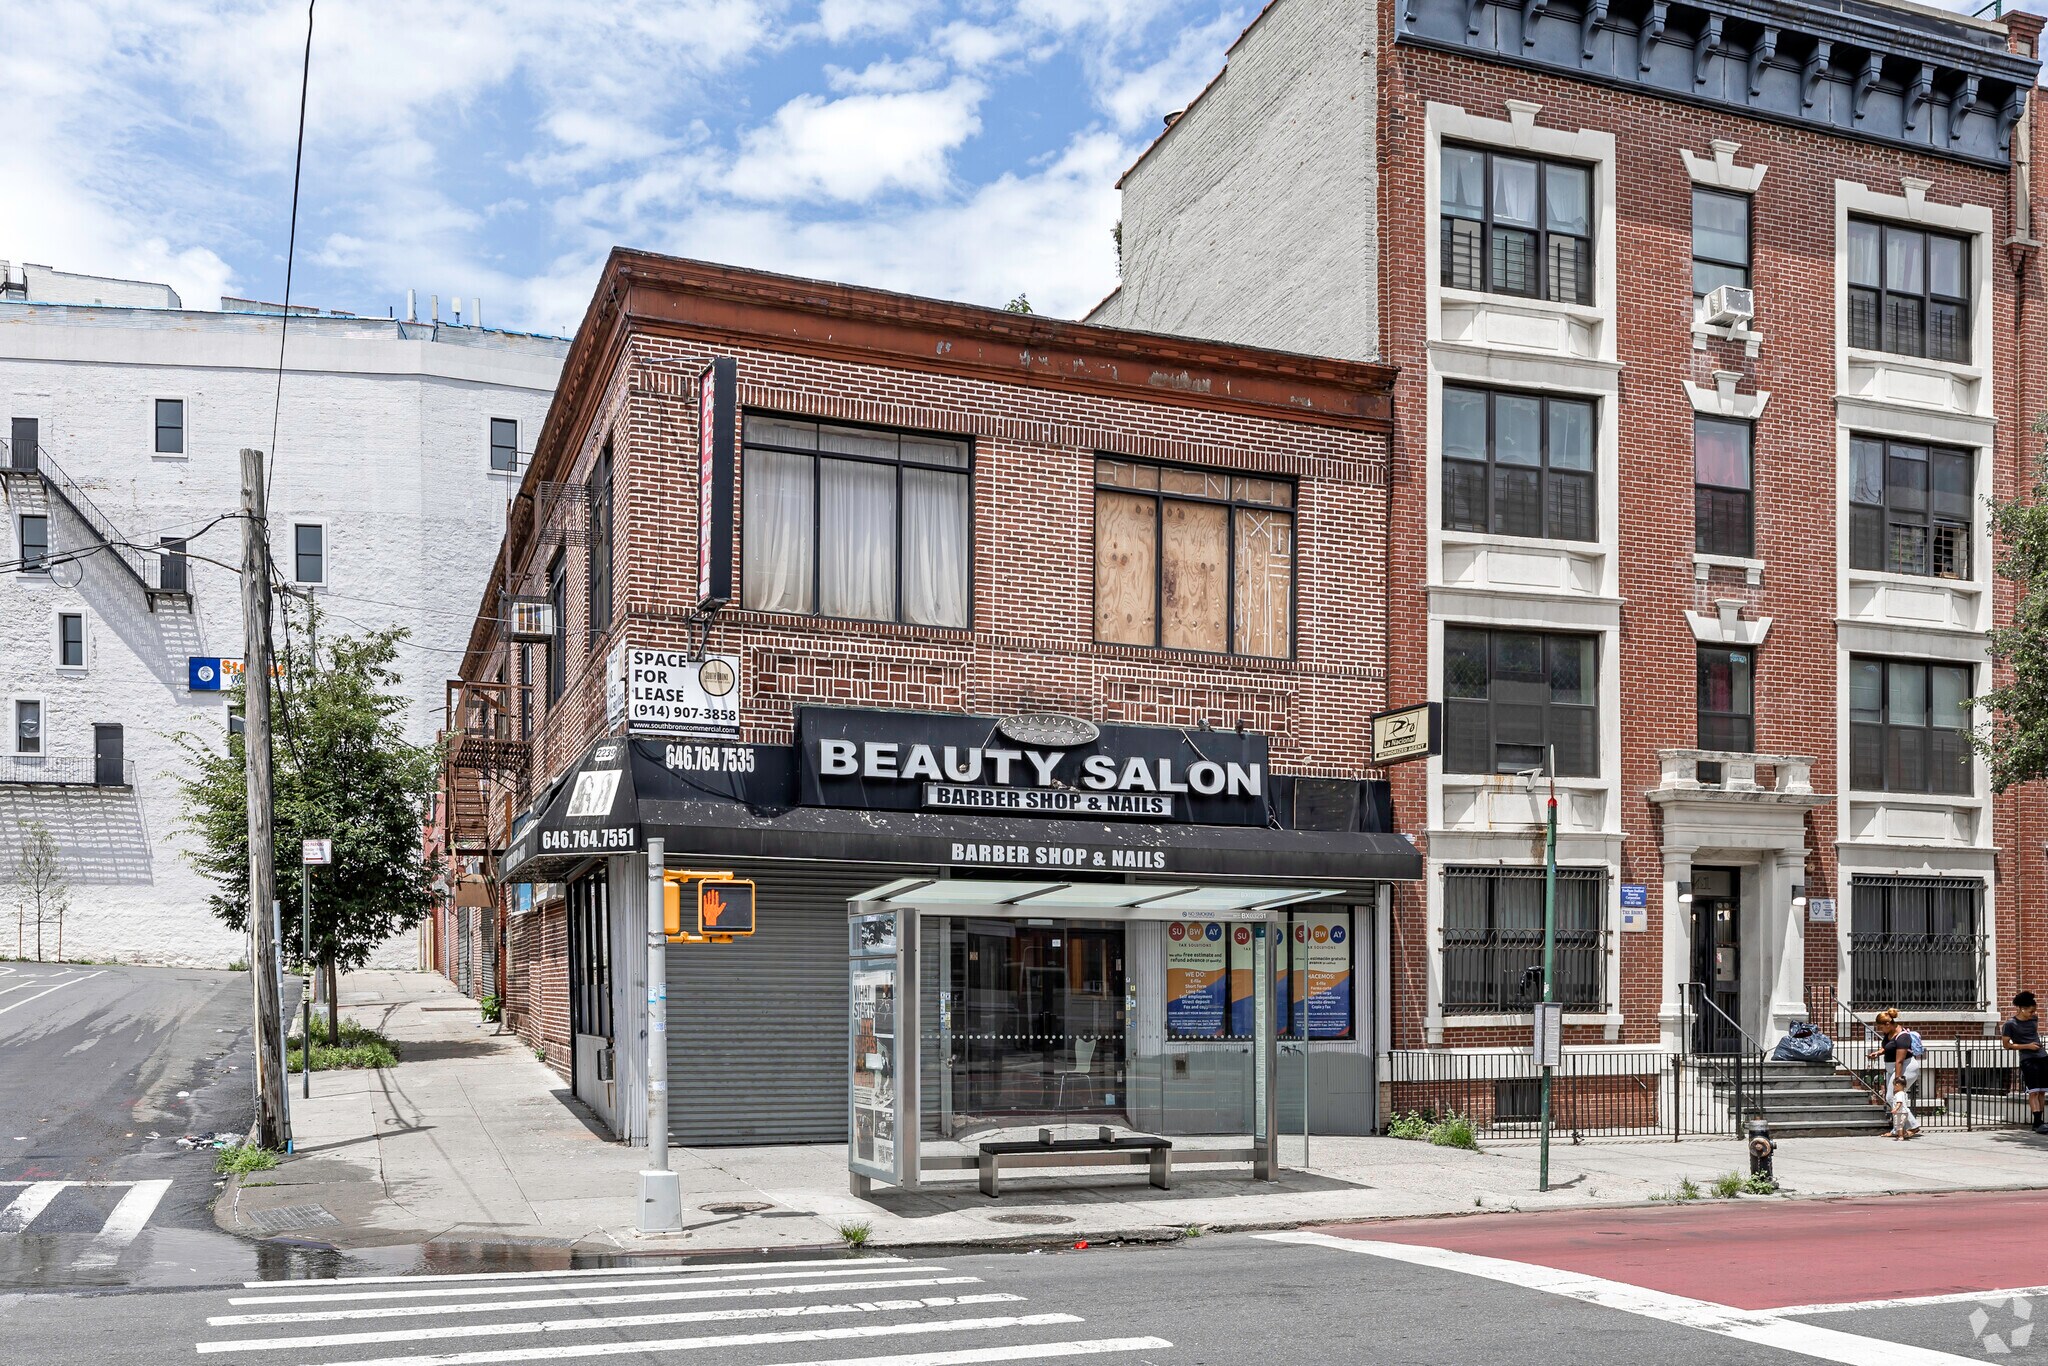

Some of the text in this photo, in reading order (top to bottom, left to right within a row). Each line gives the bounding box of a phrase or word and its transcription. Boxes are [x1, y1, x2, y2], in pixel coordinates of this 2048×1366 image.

[634, 651, 687, 668] SPACE
[634, 669, 668, 684] FOR
[634, 687, 684, 702] LEASE
[634, 704, 736, 721] (914) 907-3858
[633, 722, 736, 734] www.southbronxcommercial.com
[721, 747, 755, 773] 7535
[820, 738, 1263, 797] BEAUTY SALON
[936, 786, 1164, 814] BARBER SHOP & NAILS
[542, 827, 635, 850] 646.764.7551
[951, 842, 1166, 869] BARBER SHOP & NAILS
[1208, 928, 1219, 936] AY
[1237, 932, 1247, 940] SU
[1315, 930, 1327, 938] BW
[1333, 930, 1343, 938] AY
[853, 984, 872, 1001] WHAT
[853, 1002, 876, 1019] STARTS
